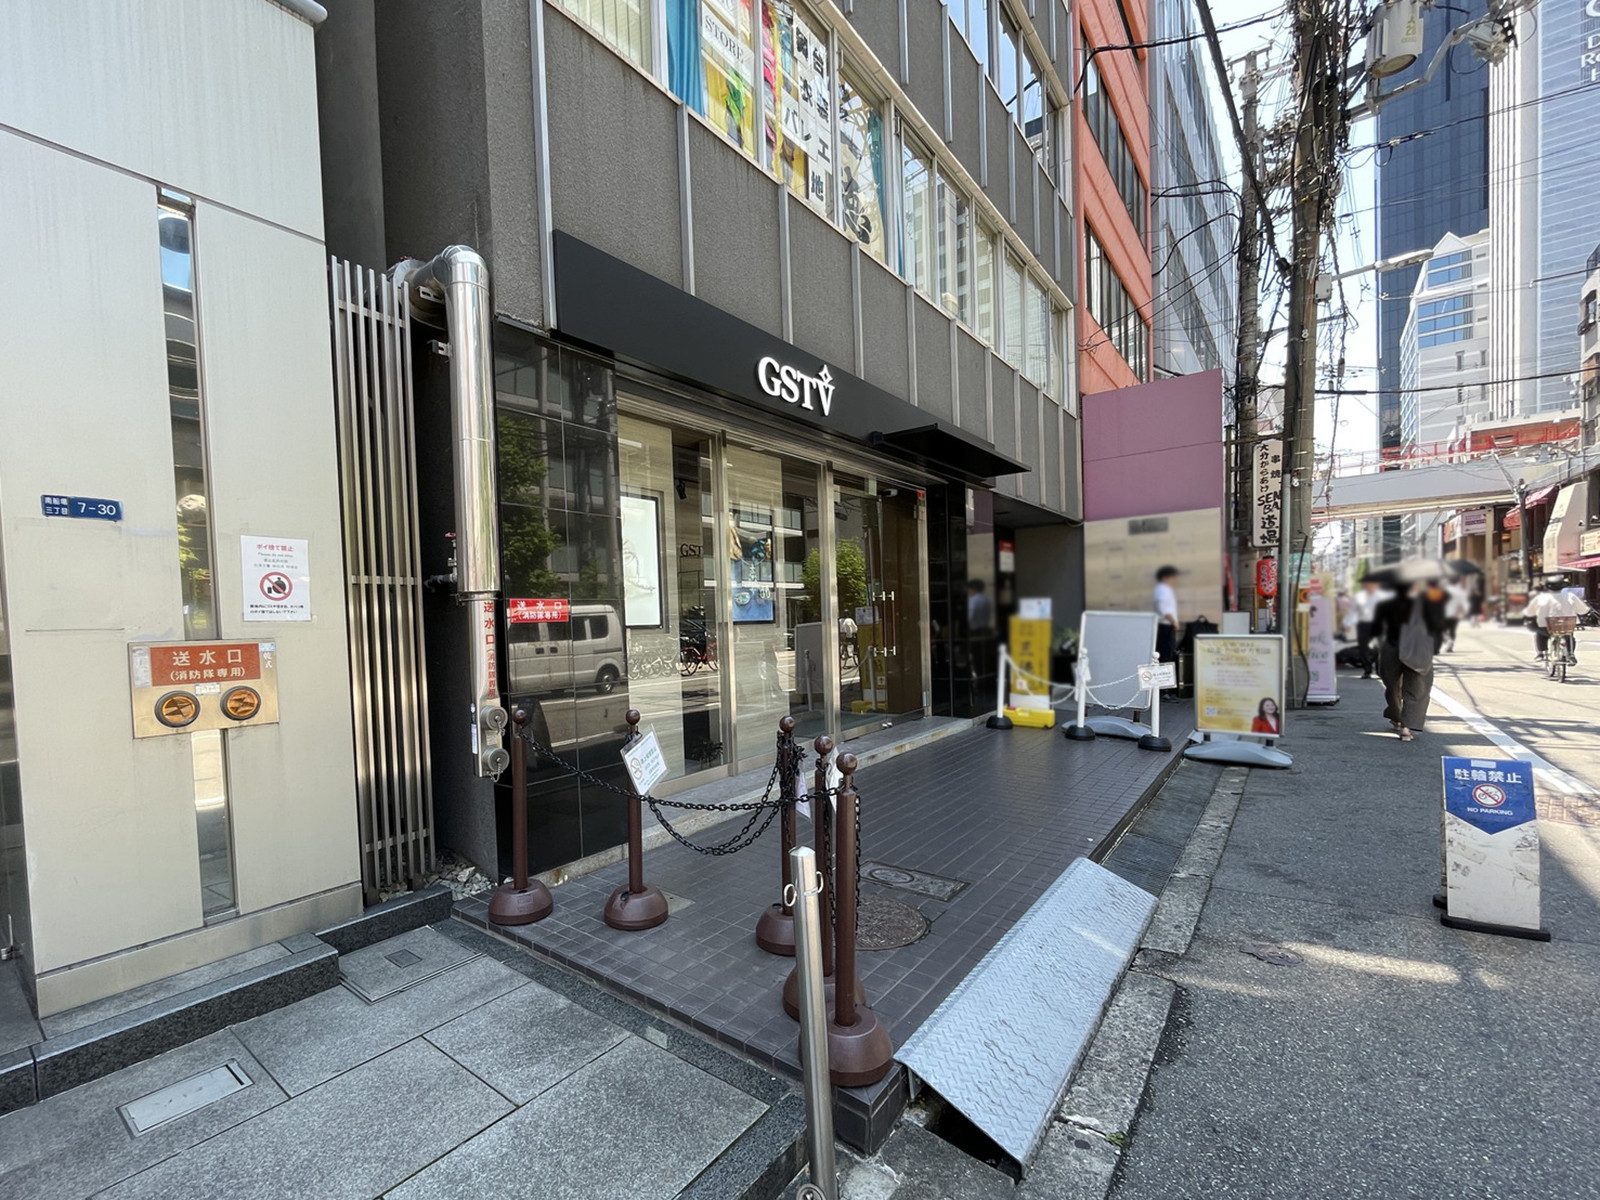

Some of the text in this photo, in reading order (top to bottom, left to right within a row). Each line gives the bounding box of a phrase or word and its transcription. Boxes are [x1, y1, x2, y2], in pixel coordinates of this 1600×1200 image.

[704, 15, 744, 64] STORE
[758, 357, 836, 417] GSTV
[46, 506, 68, 515] 三丁目
[77, 502, 116, 516] 7-30
[517, 600, 562, 610] 送水口
[484, 601, 495, 645] 送水口
[172, 649, 242, 666] 送水口
[170, 667, 245, 681] (消防隊専用)
[1454, 768, 1523, 784] 駐輪禁止
[1480, 807, 1514, 816] PARKING
